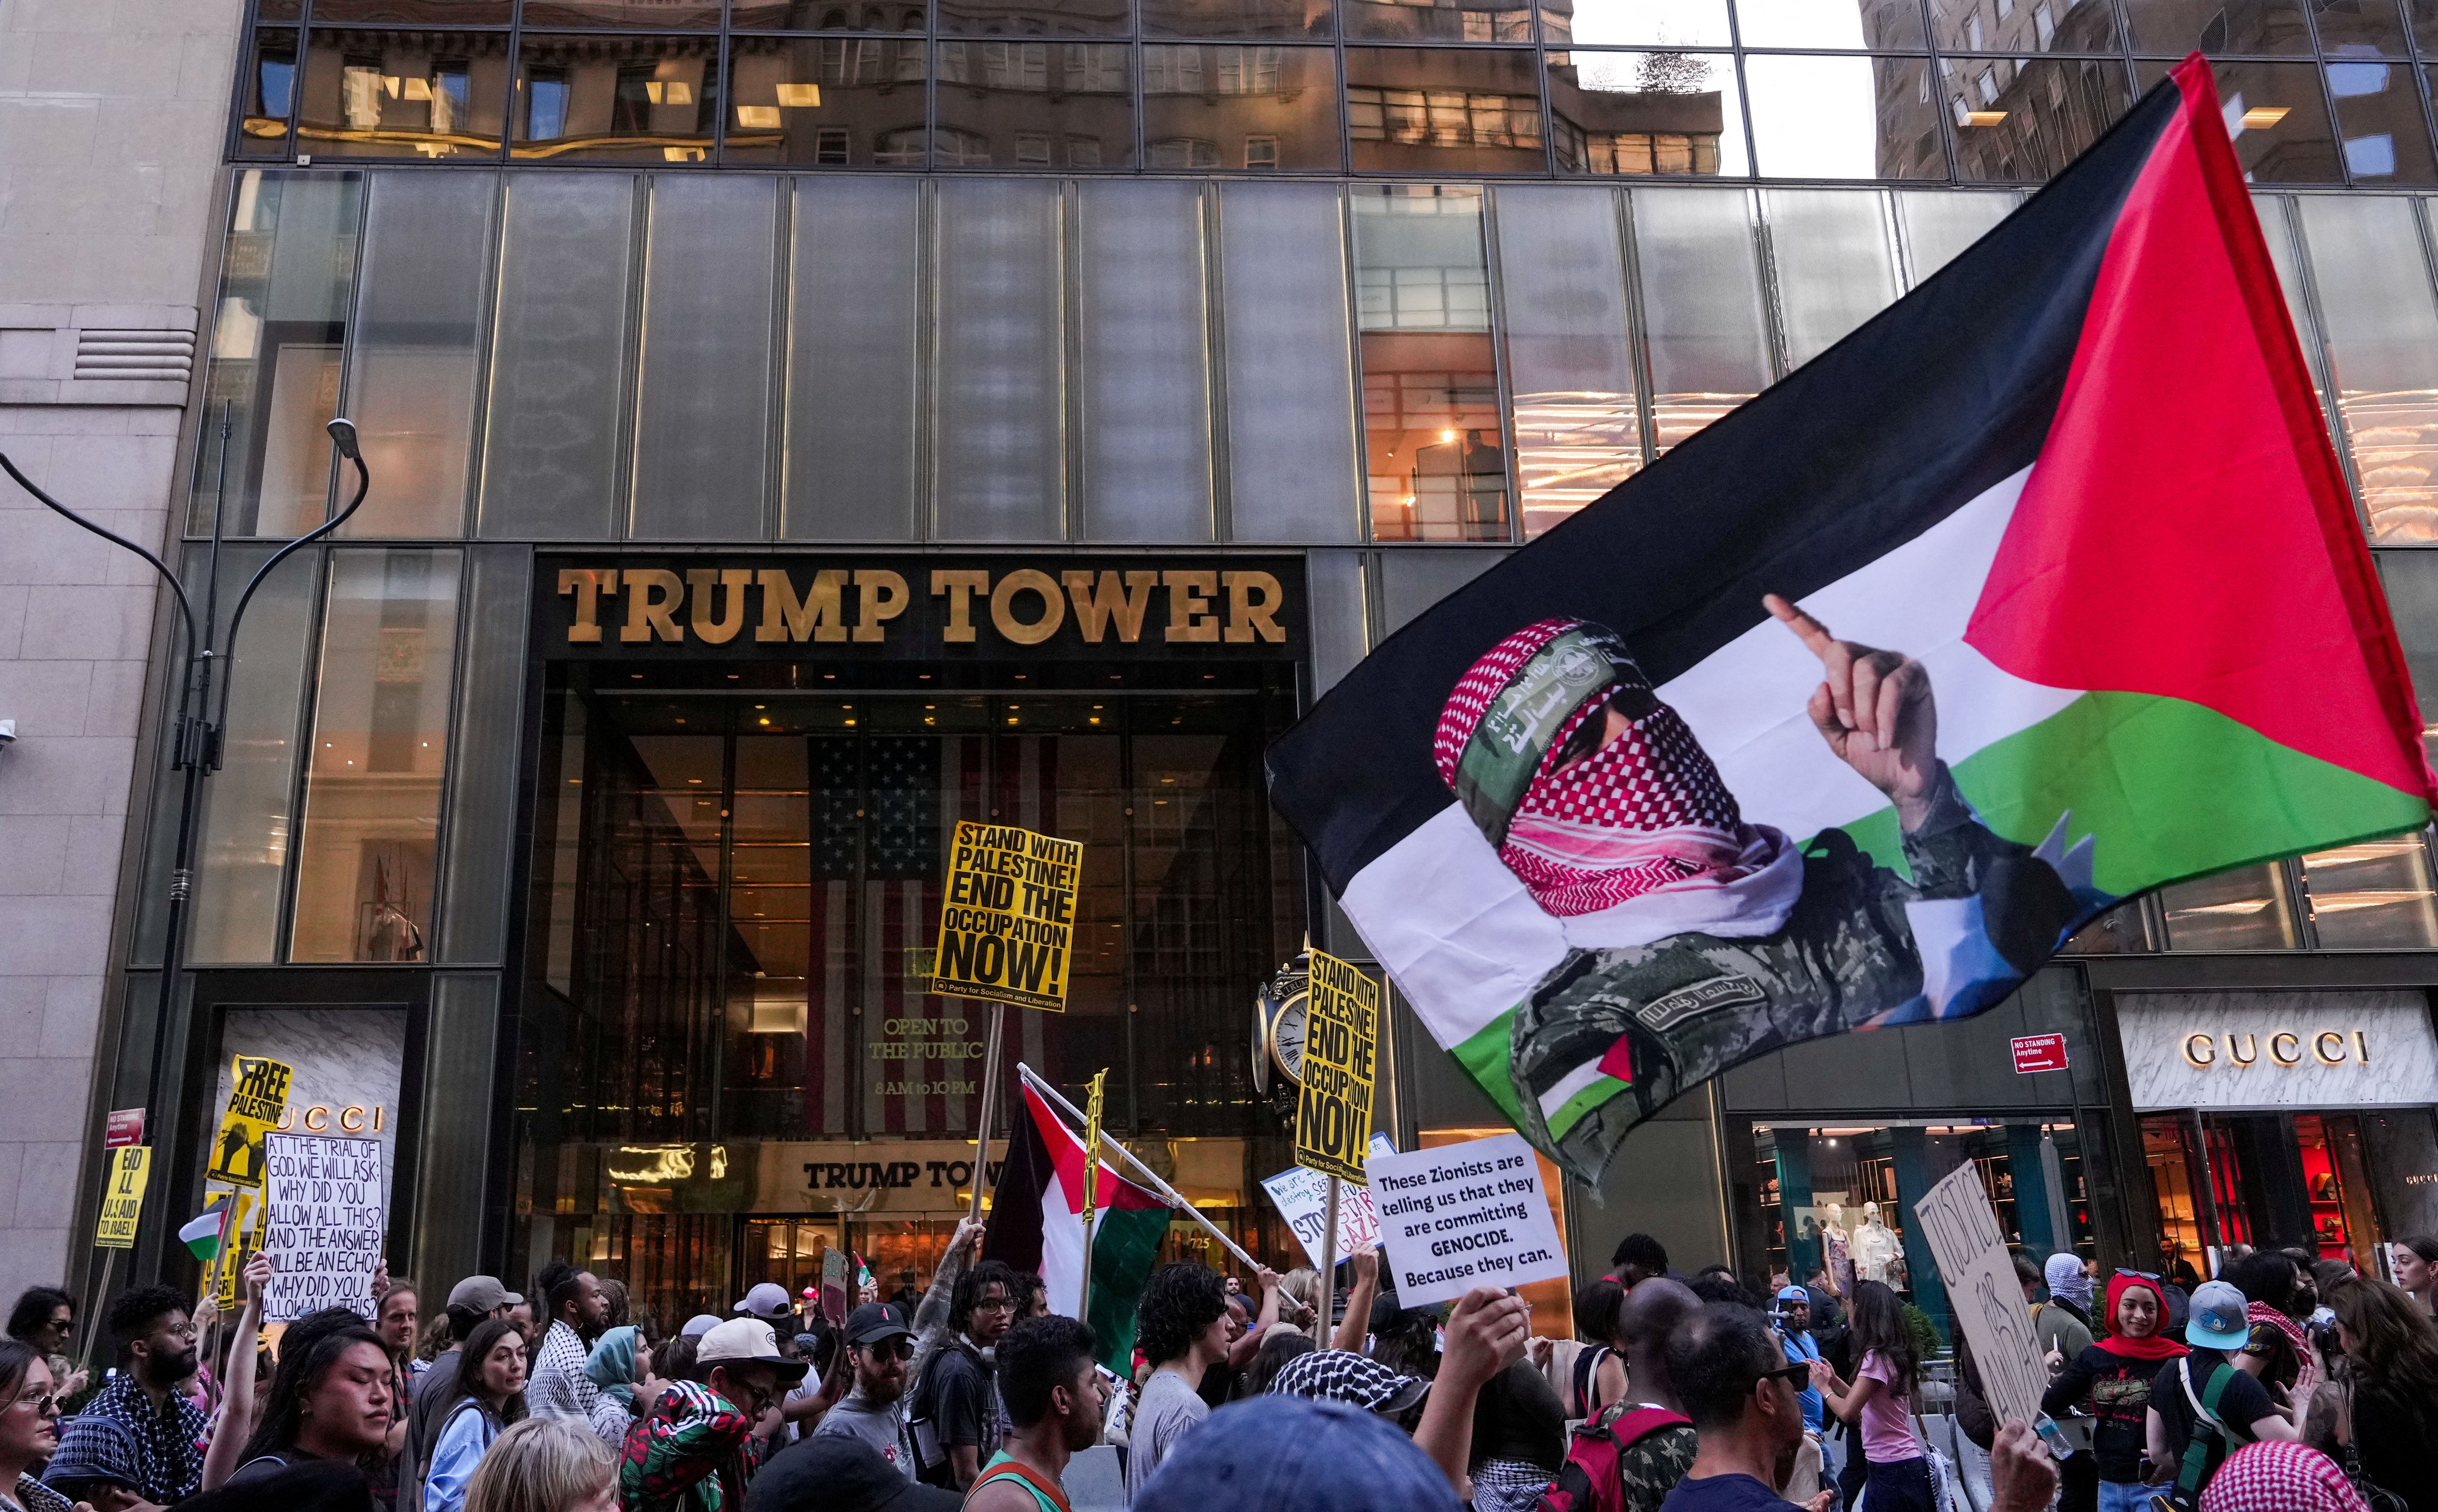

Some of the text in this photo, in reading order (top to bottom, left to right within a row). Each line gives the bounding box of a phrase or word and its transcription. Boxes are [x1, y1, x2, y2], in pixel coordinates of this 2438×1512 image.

[558, 567, 1287, 645] TRUMP TOWER
[958, 823, 1079, 866] STAND WITH
[955, 846, 1076, 891] PALESTINE!
[950, 870, 1074, 924] END THE
[944, 907, 1067, 948] OCCUPATION
[939, 930, 1063, 996] NOW!
[1312, 953, 1355, 995] STAND
[948, 984, 967, 993] Party
[980, 988, 1013, 1000] Socialism
[1027, 997, 1061, 1008] Liberation
[1283, 978, 1309, 993] TRUM
[884, 1018, 969, 1035] OPEN TO
[869, 1041, 984, 1060] THE PUBLIC
[1307, 1014, 1349, 1066] END
[2025, 1038, 2056, 1048] STANDING
[2184, 1030, 2370, 1065] GUCCI
[2016, 1048, 2042, 1057] Anytime
[238, 1058, 290, 1104] FREE
[916, 1084, 930, 1094] to
[227, 1093, 284, 1126] PALESTINE
[276, 1107, 381, 1130] UCCI
[269, 1135, 376, 1159] AT THE TRIAL OF
[268, 1155, 380, 1183] GOD, WE WILL ASK:
[1305, 1155, 1318, 1167] Party
[804, 1160, 1005, 1189] TRUMP TOW
[1271, 1182, 1288, 1196] We
[1288, 1175, 1305, 1189] are
[1379, 1155, 1524, 1192] These Zionists are
[2406, 1174, 2438, 1185] GUCCI
[278, 1179, 365, 1205] WHY DID YOU
[1281, 1189, 1314, 1207] destroy
[1382, 1177, 1534, 1216] telling us that they
[118, 1199, 138, 1219] AID
[267, 1204, 381, 1228] ALLOW ALL THIS?
[1404, 1202, 1528, 1237] are committing
[99, 1220, 109, 1235] TO
[1920, 1165, 2002, 1288] JUSTICE
[266, 1227, 379, 1251] AND THE ANSWER
[1190, 1238, 1210, 1249] 725
[1431, 1228, 1513, 1257] GENOCIDE.
[295, 1251, 314, 1273] BE
[315, 1251, 334, 1272] AN
[1405, 1248, 1553, 1288] Because they can.
[272, 1275, 364, 1299] WHY DID YOU
[339, 1296, 378, 1318] THIS?
